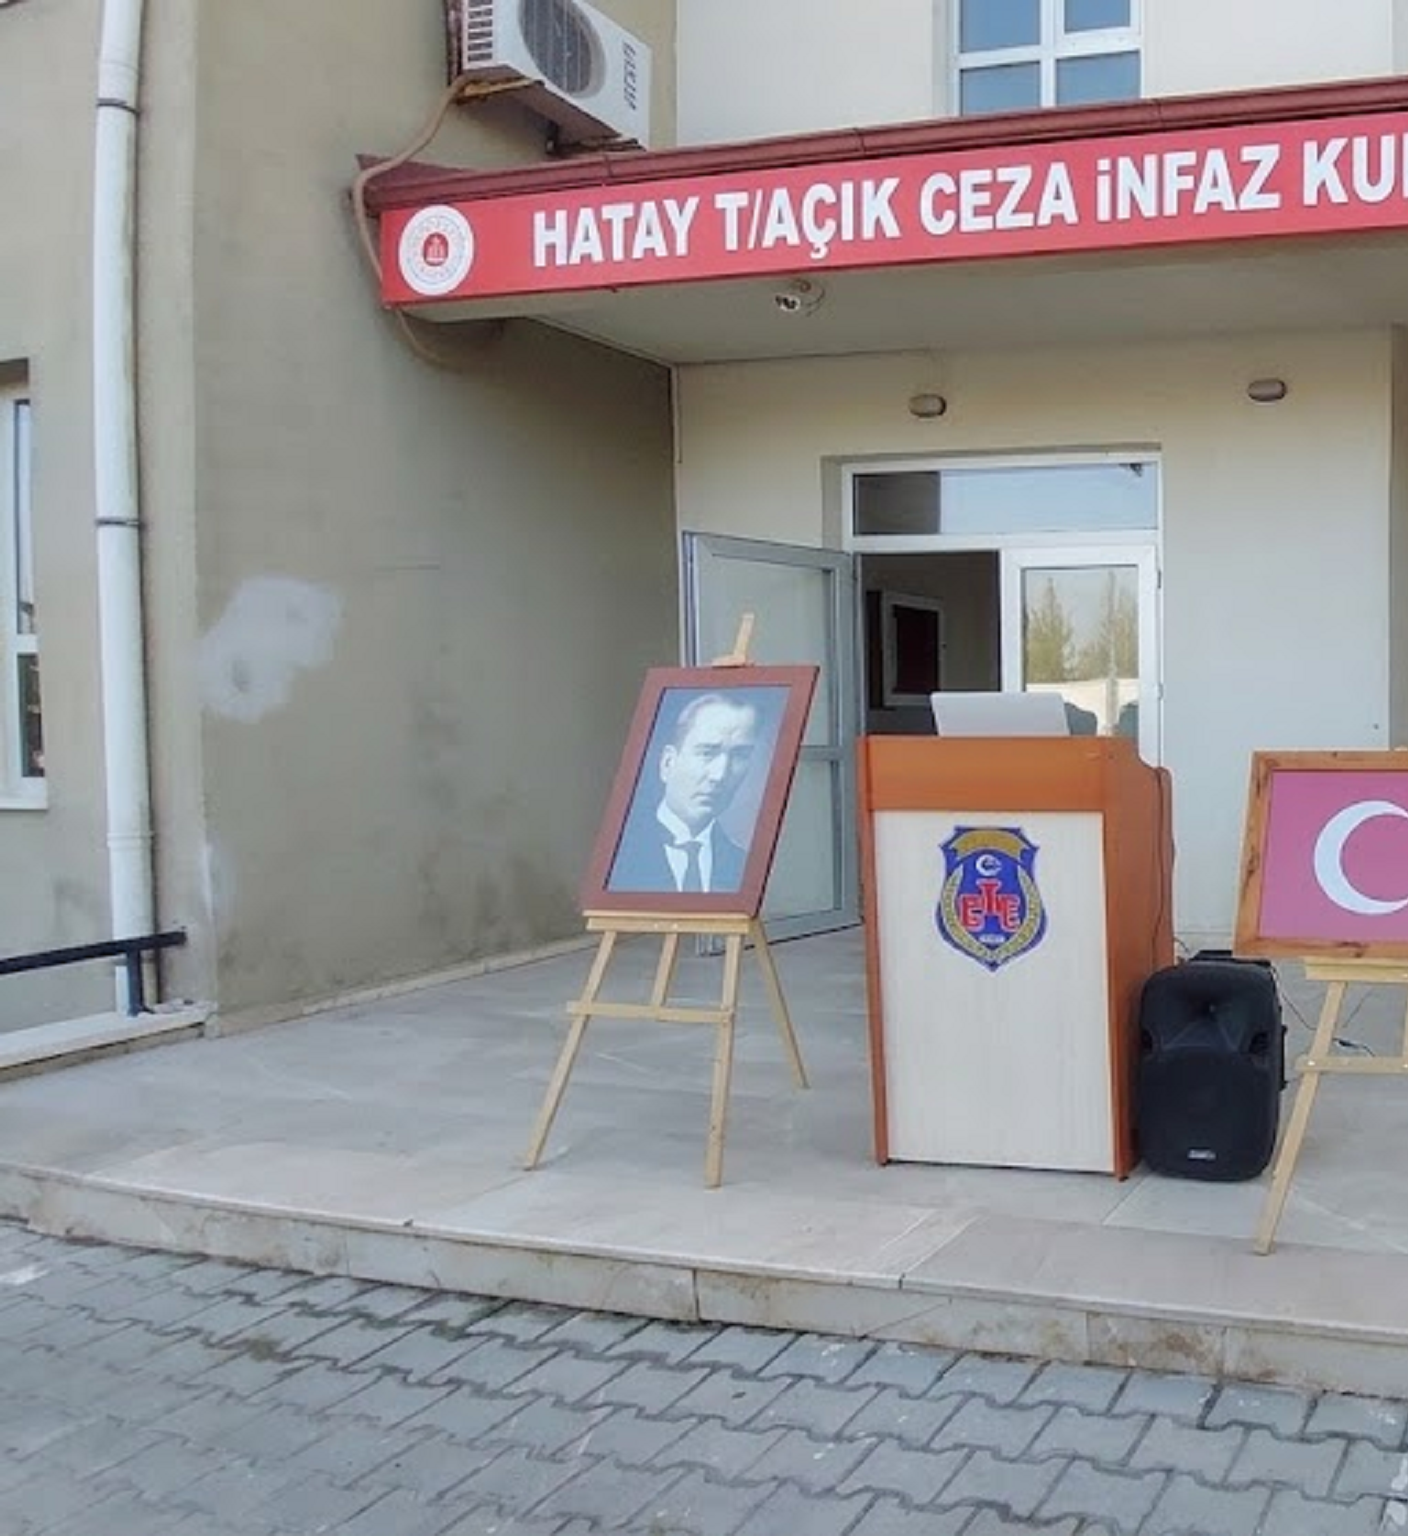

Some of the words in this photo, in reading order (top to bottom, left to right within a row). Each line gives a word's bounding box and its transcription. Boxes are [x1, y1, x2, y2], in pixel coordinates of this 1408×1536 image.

[533, 195, 700, 268] HATAY
[714, 177, 901, 260] T/AÇIK
[919, 161, 1079, 235] CEZA
